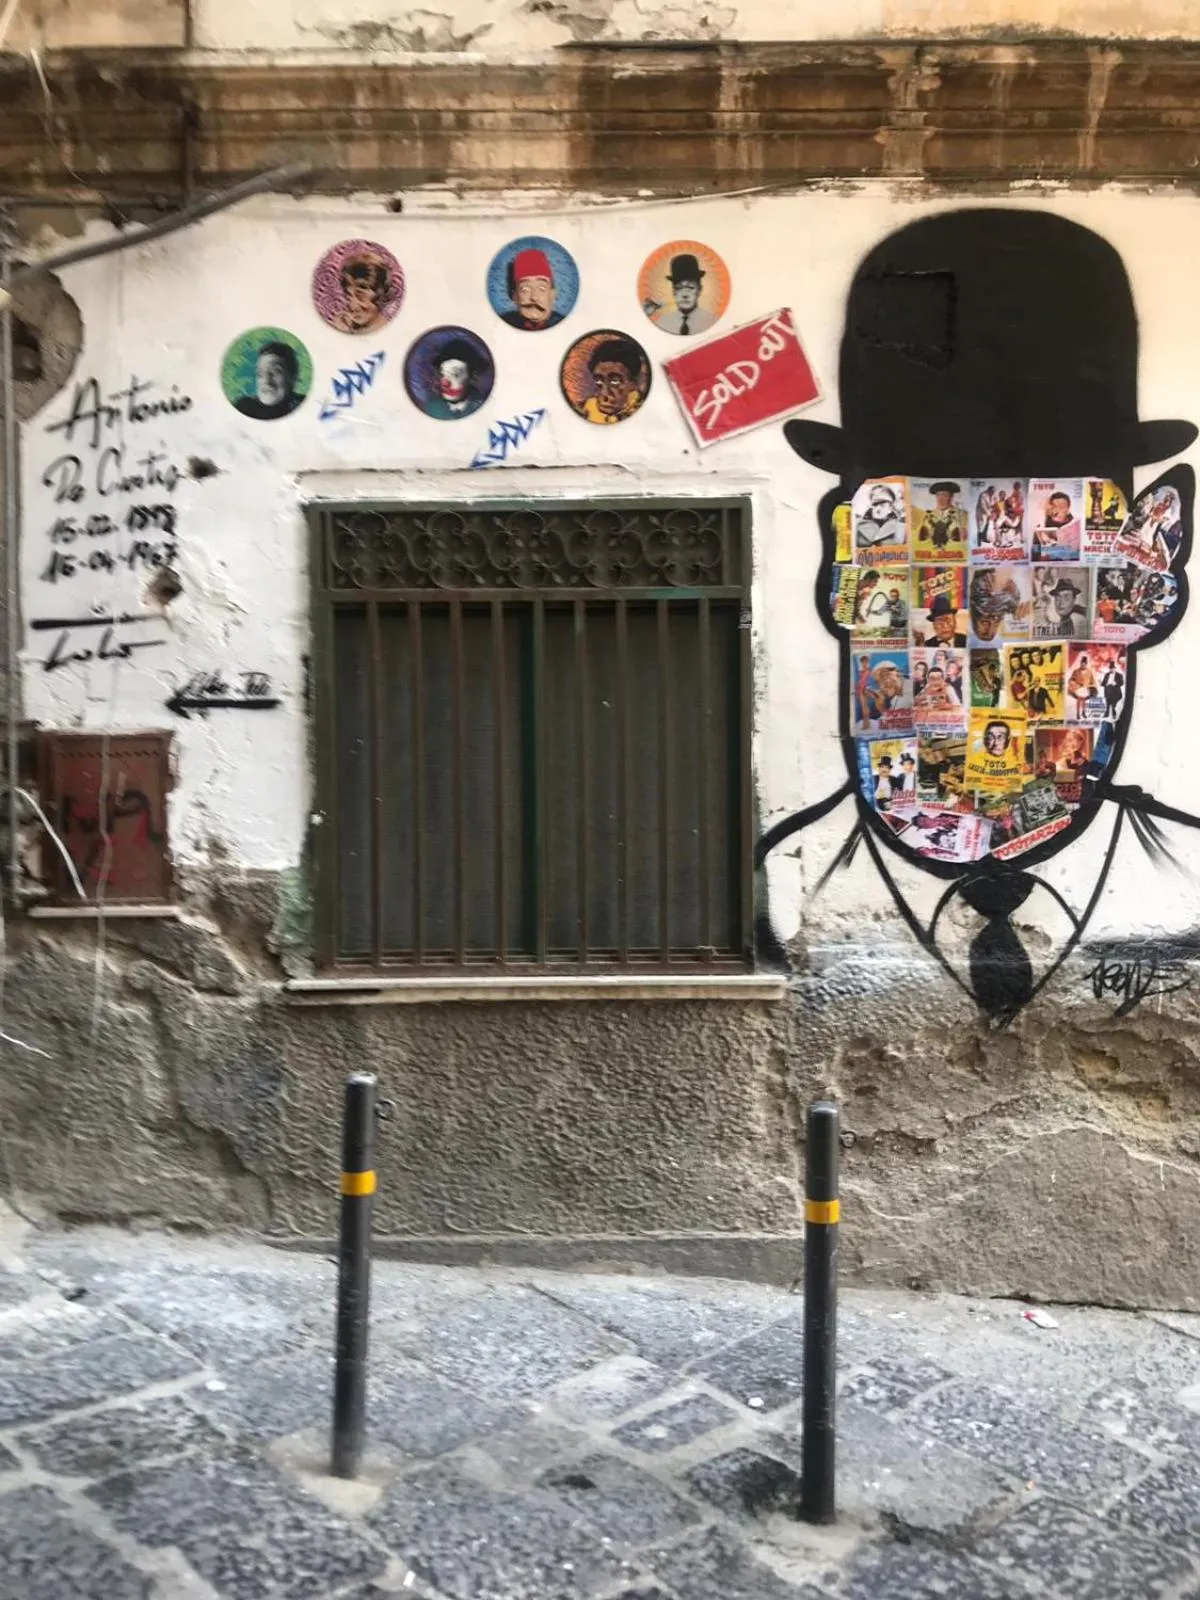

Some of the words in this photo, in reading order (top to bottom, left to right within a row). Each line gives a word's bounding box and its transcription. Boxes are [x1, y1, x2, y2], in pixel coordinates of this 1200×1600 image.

[44, 375, 192, 450] Antonio
[693, 360, 760, 430] SOLD
[919, 571, 956, 591] TOTO
[984, 759, 1007, 769] TOTO
